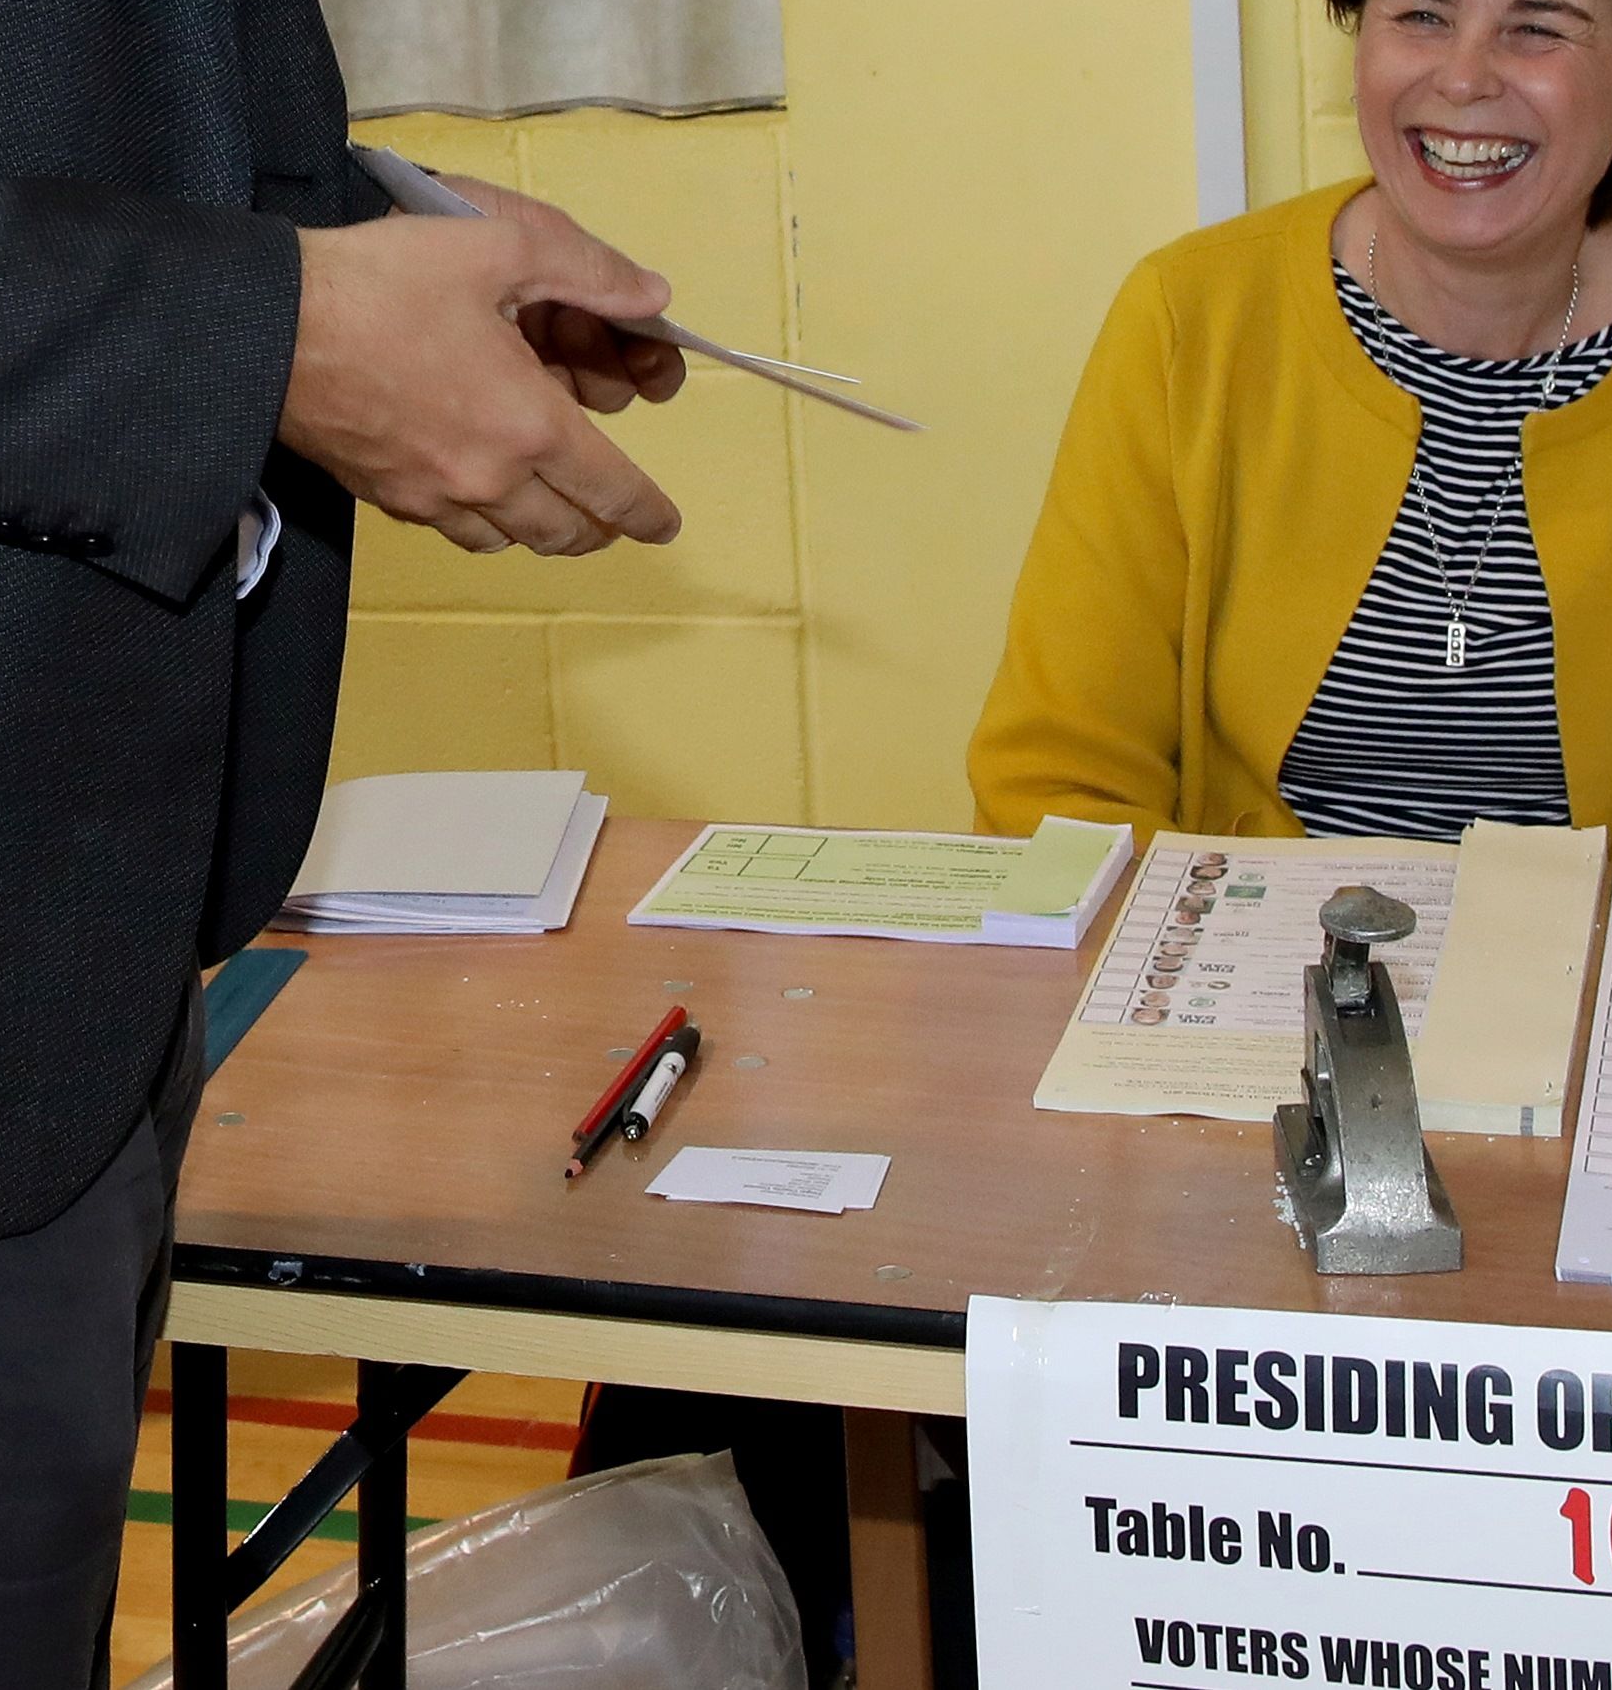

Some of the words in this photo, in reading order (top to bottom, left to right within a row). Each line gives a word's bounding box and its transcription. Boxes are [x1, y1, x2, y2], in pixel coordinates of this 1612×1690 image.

[1117, 1341, 1513, 1448] PRESIDING
[1085, 1495, 1244, 1568] Table
[1257, 1505, 1347, 1577] No.
[1135, 1617, 1310, 1680] VOTERS
[1320, 1636, 1490, 1690] WHOSE
